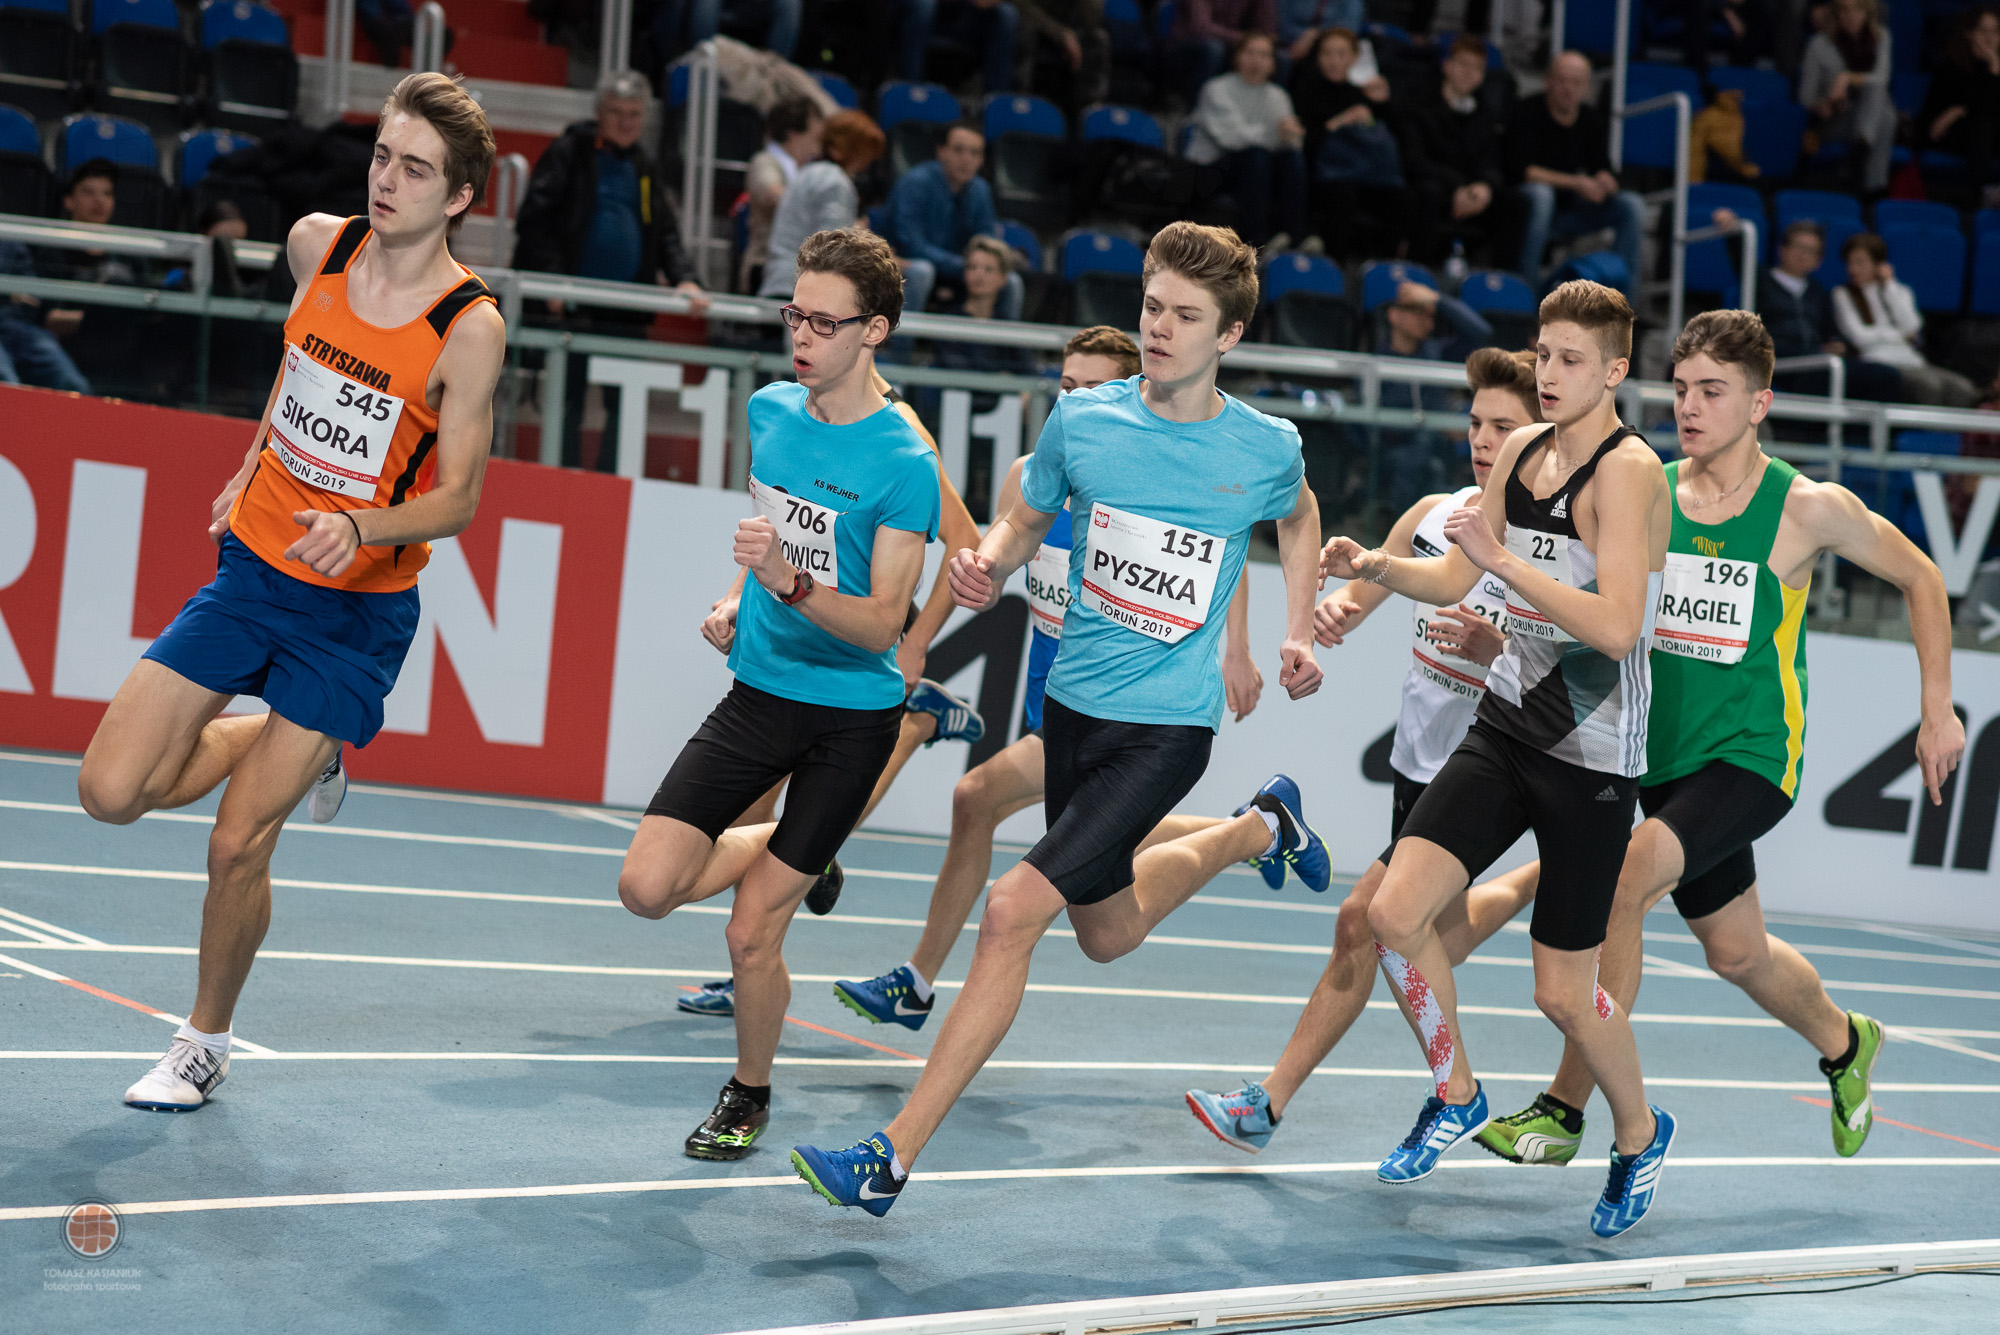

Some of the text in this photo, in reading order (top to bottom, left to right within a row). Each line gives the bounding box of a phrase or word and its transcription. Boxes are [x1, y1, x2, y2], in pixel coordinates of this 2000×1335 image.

[301, 333, 391, 392] STRYSZAWA
[336, 382, 393, 421] 545
[282, 395, 368, 459] SIKORA
[281, 447, 346, 490] TORUŃ 2019
[290, 446, 327, 468] MISTRZOSTWA
[326, 464, 348, 476] POLSKI
[347, 471, 359, 479] U18
[358, 474, 372, 482] U20
[814, 479, 824, 489] KS
[827, 484, 859, 502] WEJHER
[785, 499, 827, 535] 706
[780, 538, 830, 572] OWICZ
[1161, 529, 1214, 564] 151
[1532, 535, 1556, 561] 22
[1093, 549, 1196, 605] PYSZKA
[1704, 561, 1748, 587] 196
[1099, 601, 1172, 638] TORUŃ 2019
[1114, 598, 1154, 615] MISTRZOSTWA
[1154, 611, 1175, 621] POLSKI
[1659, 594, 1741, 626] RĄGIEL
[1510, 616, 1555, 638] TORUŃ 2019
[1660, 639, 1722, 658] TORUŃ 2019
[1423, 666, 1452, 689] TORUŃ
[1453, 682, 1479, 699] 2019
